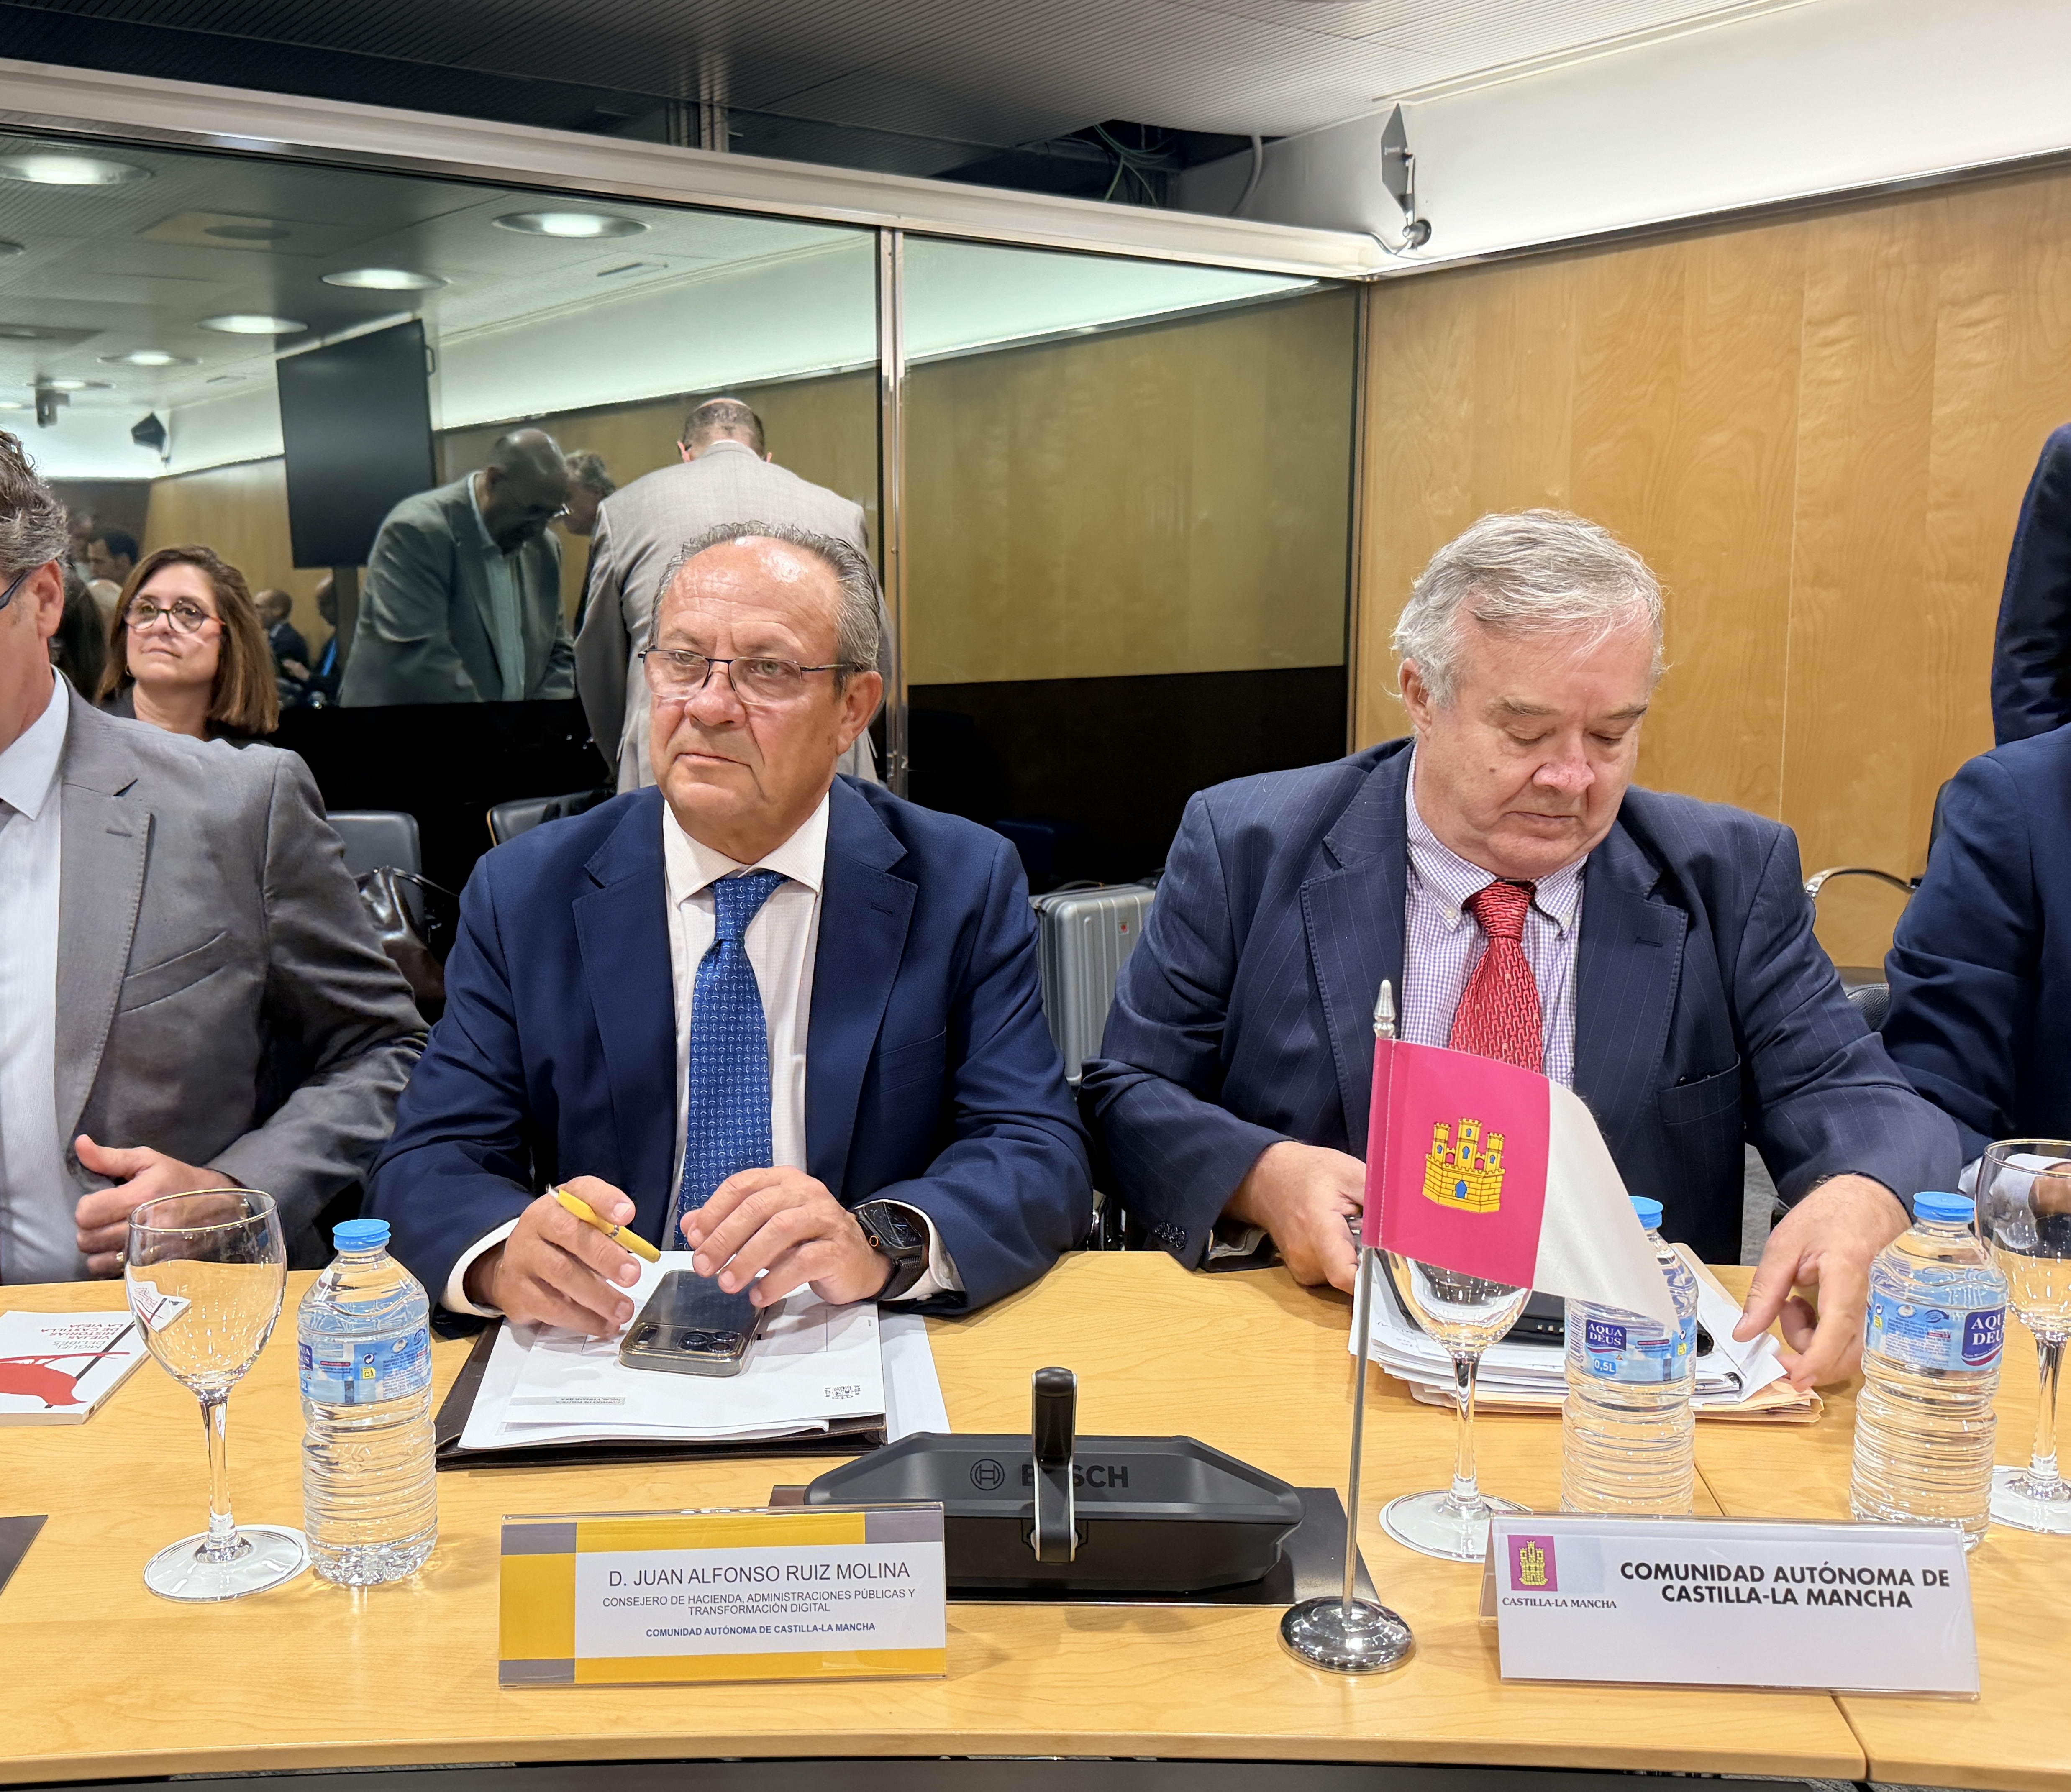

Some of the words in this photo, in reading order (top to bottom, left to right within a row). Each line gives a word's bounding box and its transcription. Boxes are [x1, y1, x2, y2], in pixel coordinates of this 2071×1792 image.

[1588, 1323, 1623, 1337] AQUA
[1590, 1331, 1622, 1346] DEUS
[1594, 1361, 1615, 1373] 0,5L
[1022, 1464, 1129, 1488] BSCH
[610, 1571, 627, 1587] D.
[633, 1569, 683, 1586] JUAN
[688, 1566, 780, 1585] ALFONSO
[787, 1564, 831, 1582] RUIZ
[837, 1562, 910, 1580] MOLINA
[1620, 1562, 1765, 1582] COMUNIDAD
[1773, 1561, 1915, 1587] AUTÓNOMA
[1922, 1569, 1950, 1587] DE
[602, 1596, 668, 1607] CONSEJERO
[671, 1595, 685, 1605] DE
[688, 1594, 745, 1605] HACIENDA,
[746, 1590, 851, 1603] ADMINISTRACIONES
[854, 1588, 906, 1600] PÚBLICAS
[907, 1588, 915, 1598] Y
[1502, 1597, 1568, 1608] CASTILLA-LA
[1570, 1599, 1617, 1609] MANCHA
[1661, 1584, 1799, 1605] CASTILLA-LA
[1806, 1588, 1913, 1608] MANCHA
[688, 1602, 787, 1616] TRANSFORMACIÓN
[790, 1603, 830, 1613] DIGITAL
[646, 1628, 702, 1637] COMUNIDAD
[704, 1625, 757, 1636] AUTÓNOMA
[759, 1626, 771, 1634] DE
[774, 1624, 834, 1633] CASTILLA-LA
[835, 1623, 876, 1631] MANCHA
